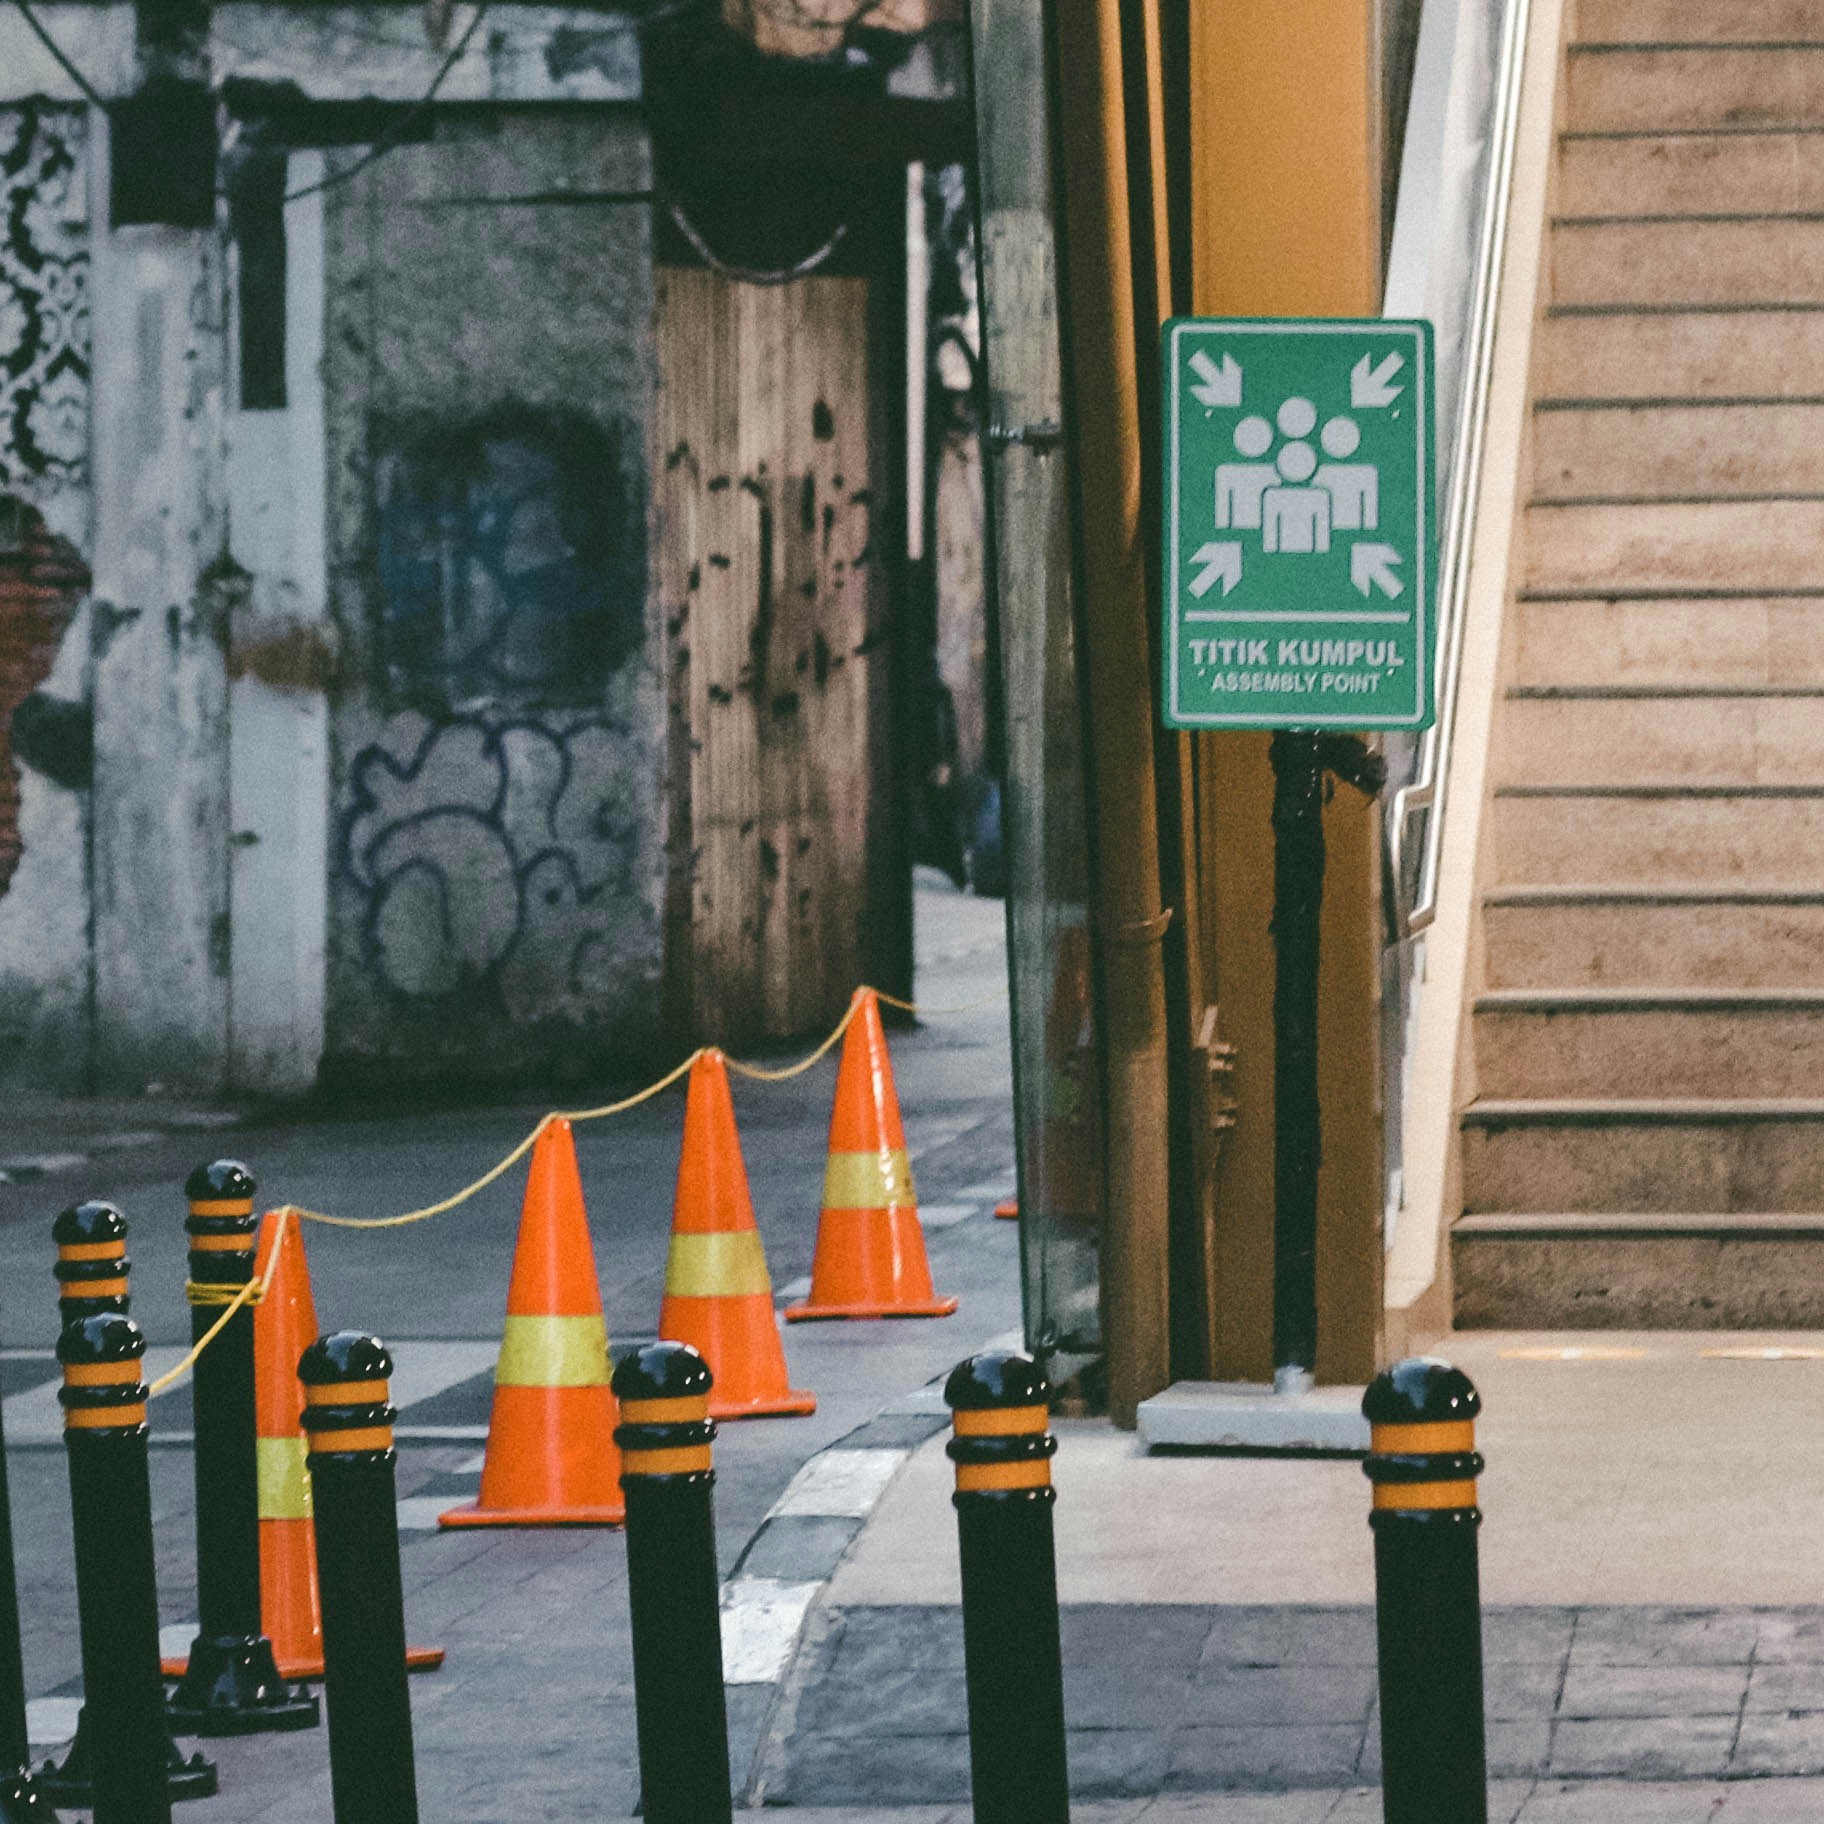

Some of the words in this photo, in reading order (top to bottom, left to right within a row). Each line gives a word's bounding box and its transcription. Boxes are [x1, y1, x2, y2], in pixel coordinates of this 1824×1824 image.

[1188, 639, 1269, 666] TITIK
[1277, 639, 1405, 667] KUMPUL
[1211, 671, 1318, 693] ASSEMBLY
[1321, 672, 1381, 694] POINT
